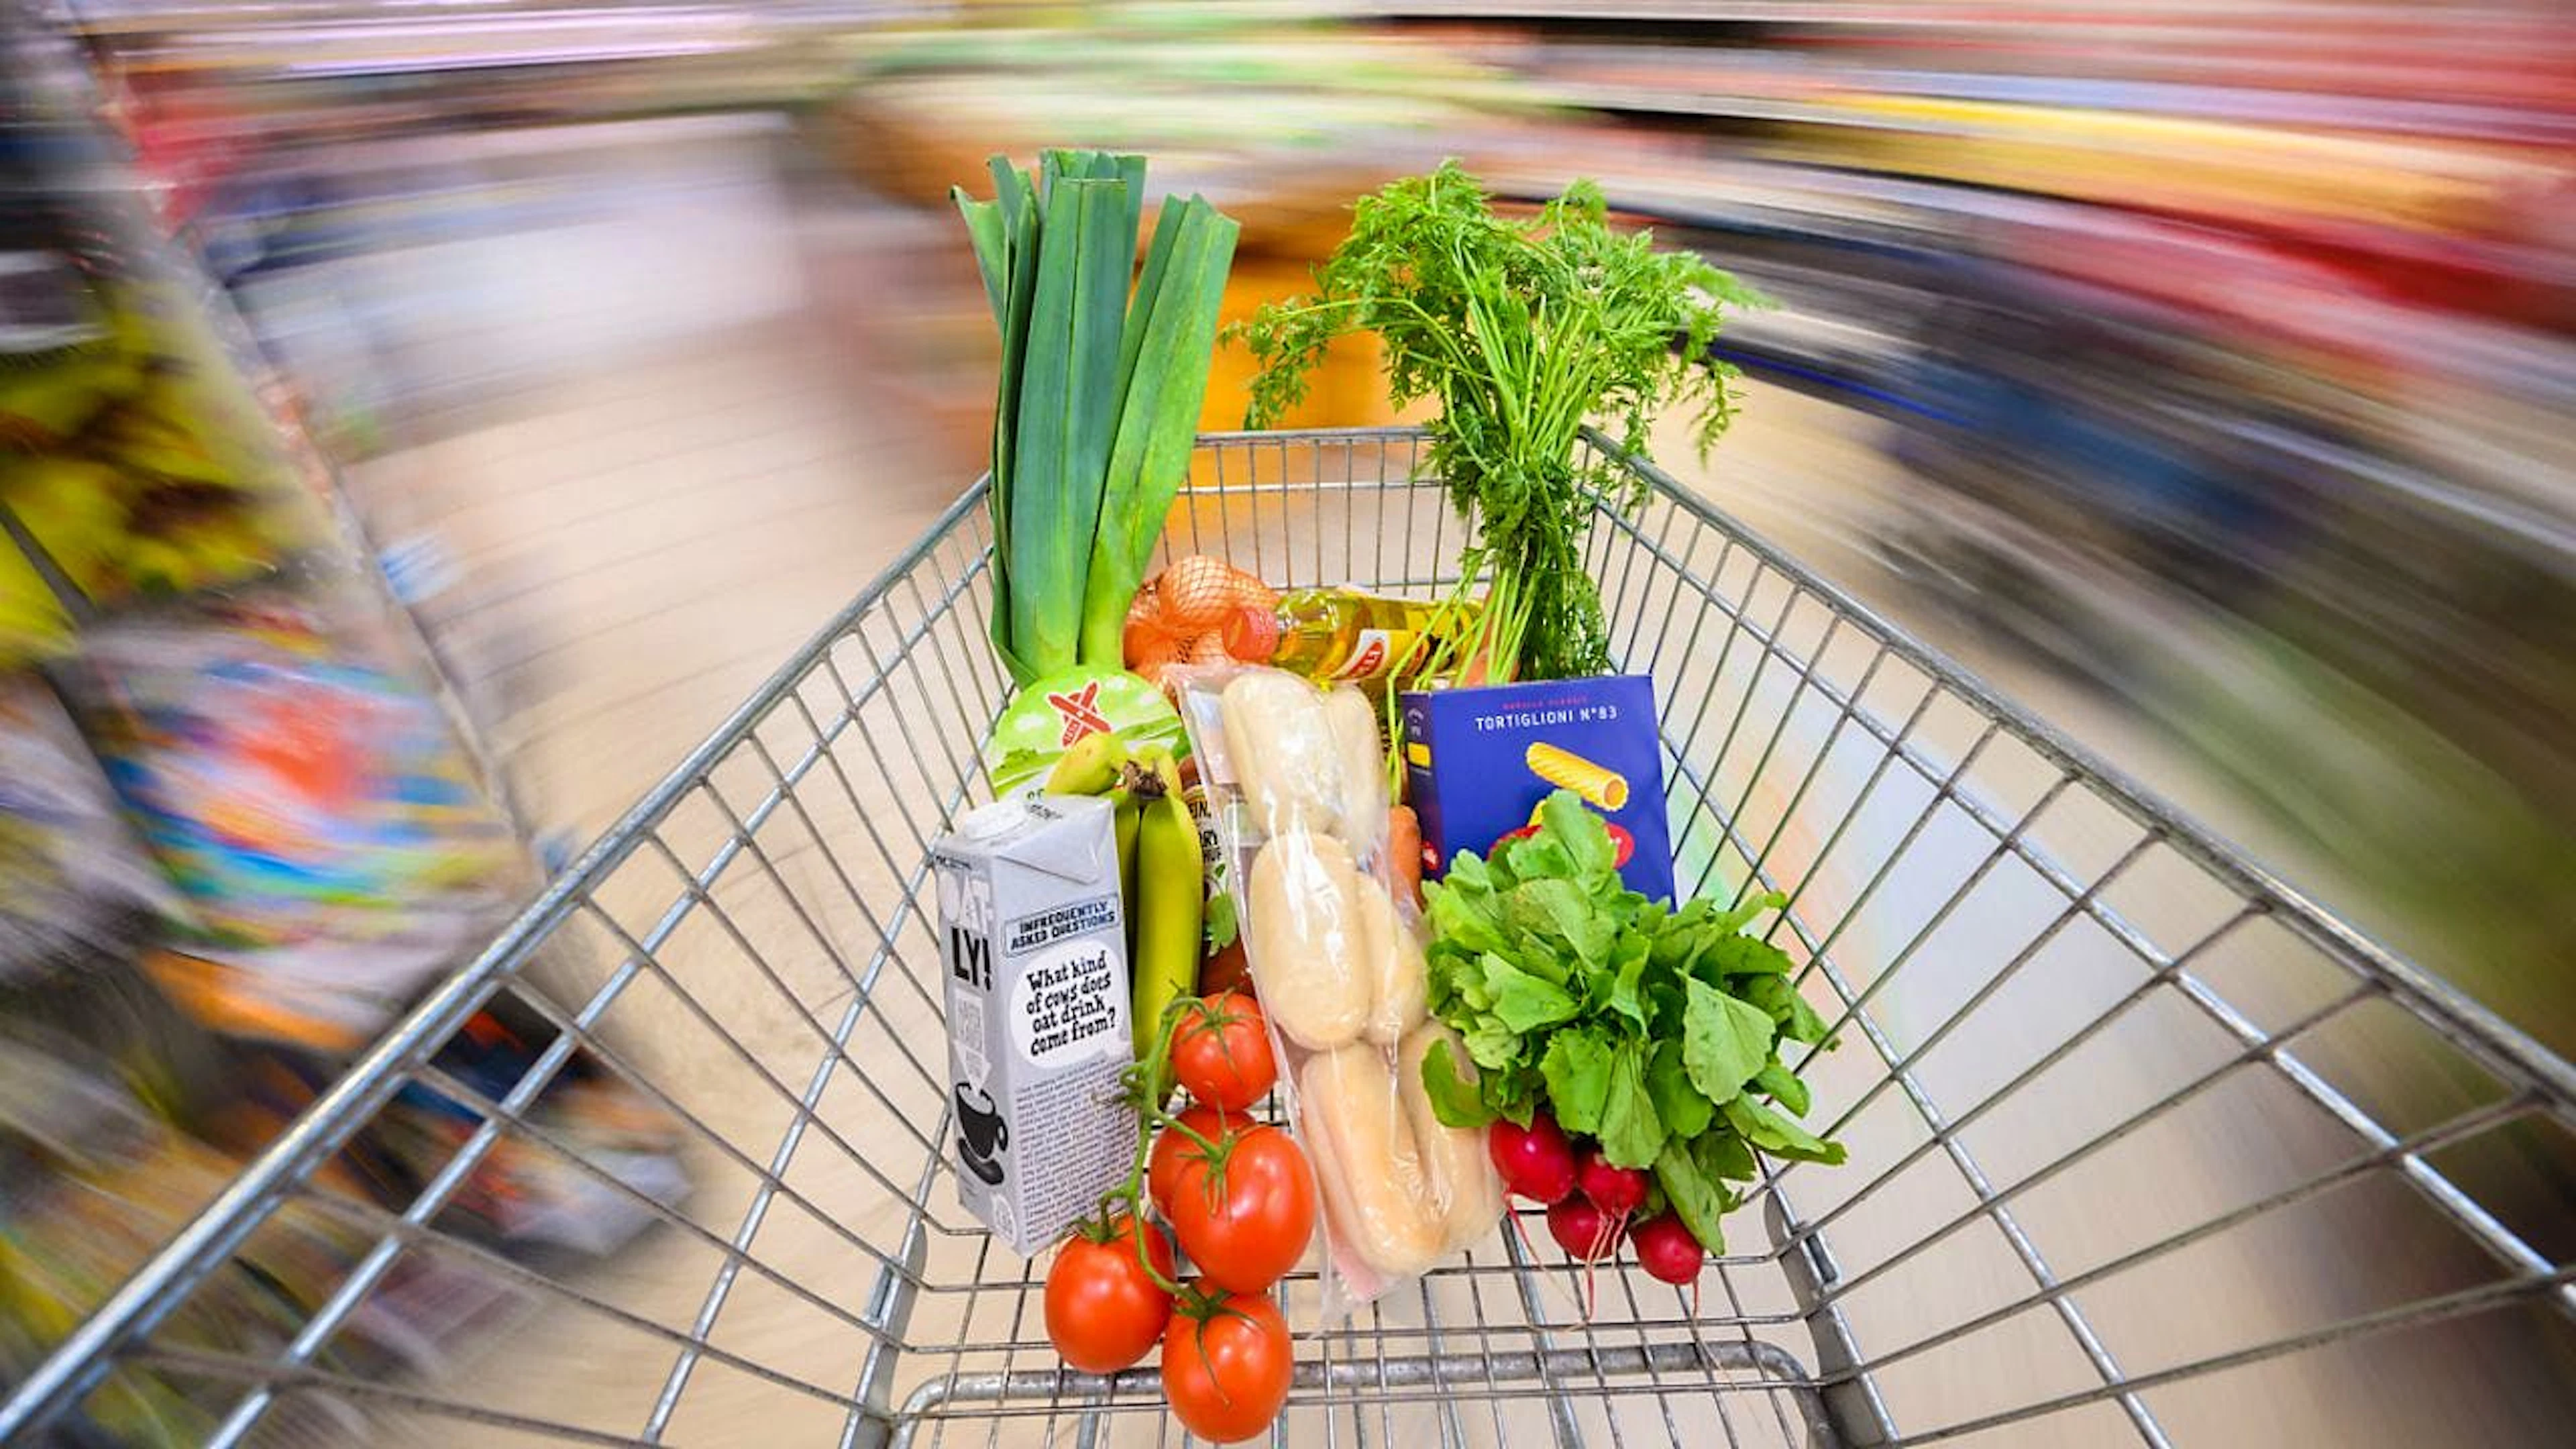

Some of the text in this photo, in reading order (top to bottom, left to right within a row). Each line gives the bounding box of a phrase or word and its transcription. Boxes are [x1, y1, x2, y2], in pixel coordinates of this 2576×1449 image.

[1474, 709, 1574, 731] TORTIGLIONI
[1010, 912, 1115, 950] ASKED QUESTIONS
[1020, 901, 1108, 933] INFREQUENTLY
[951, 926, 991, 991] LY!
[1026, 950, 1106, 991] What kind
[1026, 972, 1112, 1014] of cows does
[1030, 1007, 1116, 1056] come from?
[1032, 994, 1105, 1034] oat drink
